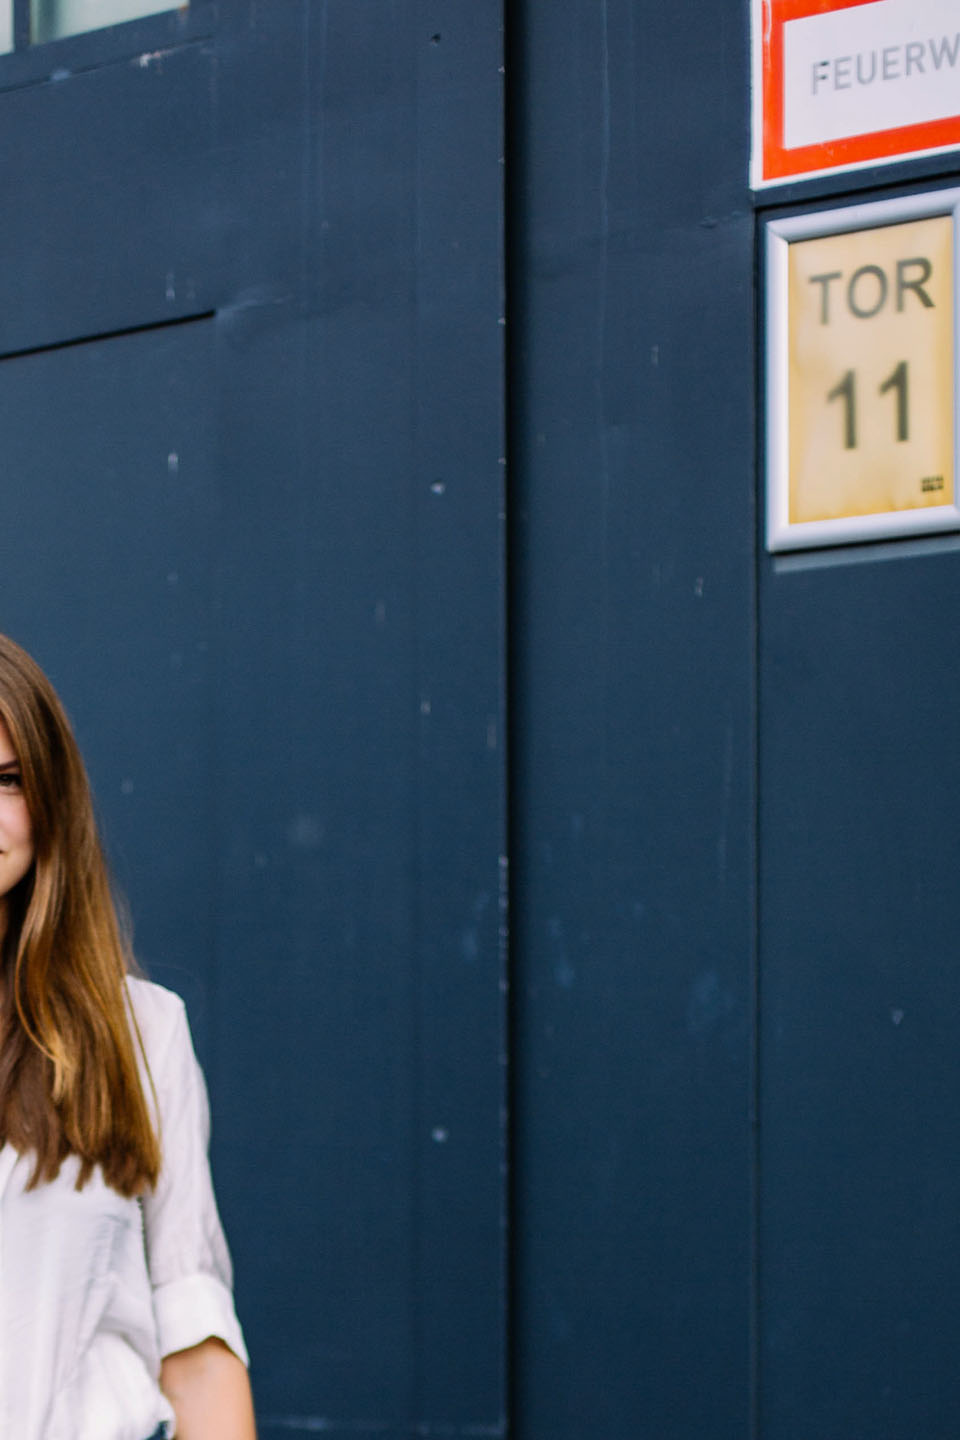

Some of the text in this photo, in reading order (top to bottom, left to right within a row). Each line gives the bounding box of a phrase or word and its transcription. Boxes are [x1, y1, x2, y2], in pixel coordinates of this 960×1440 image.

[812, 32, 960, 96] FEUERW
[809, 257, 936, 325] TOR
[827, 360, 909, 449] 11
